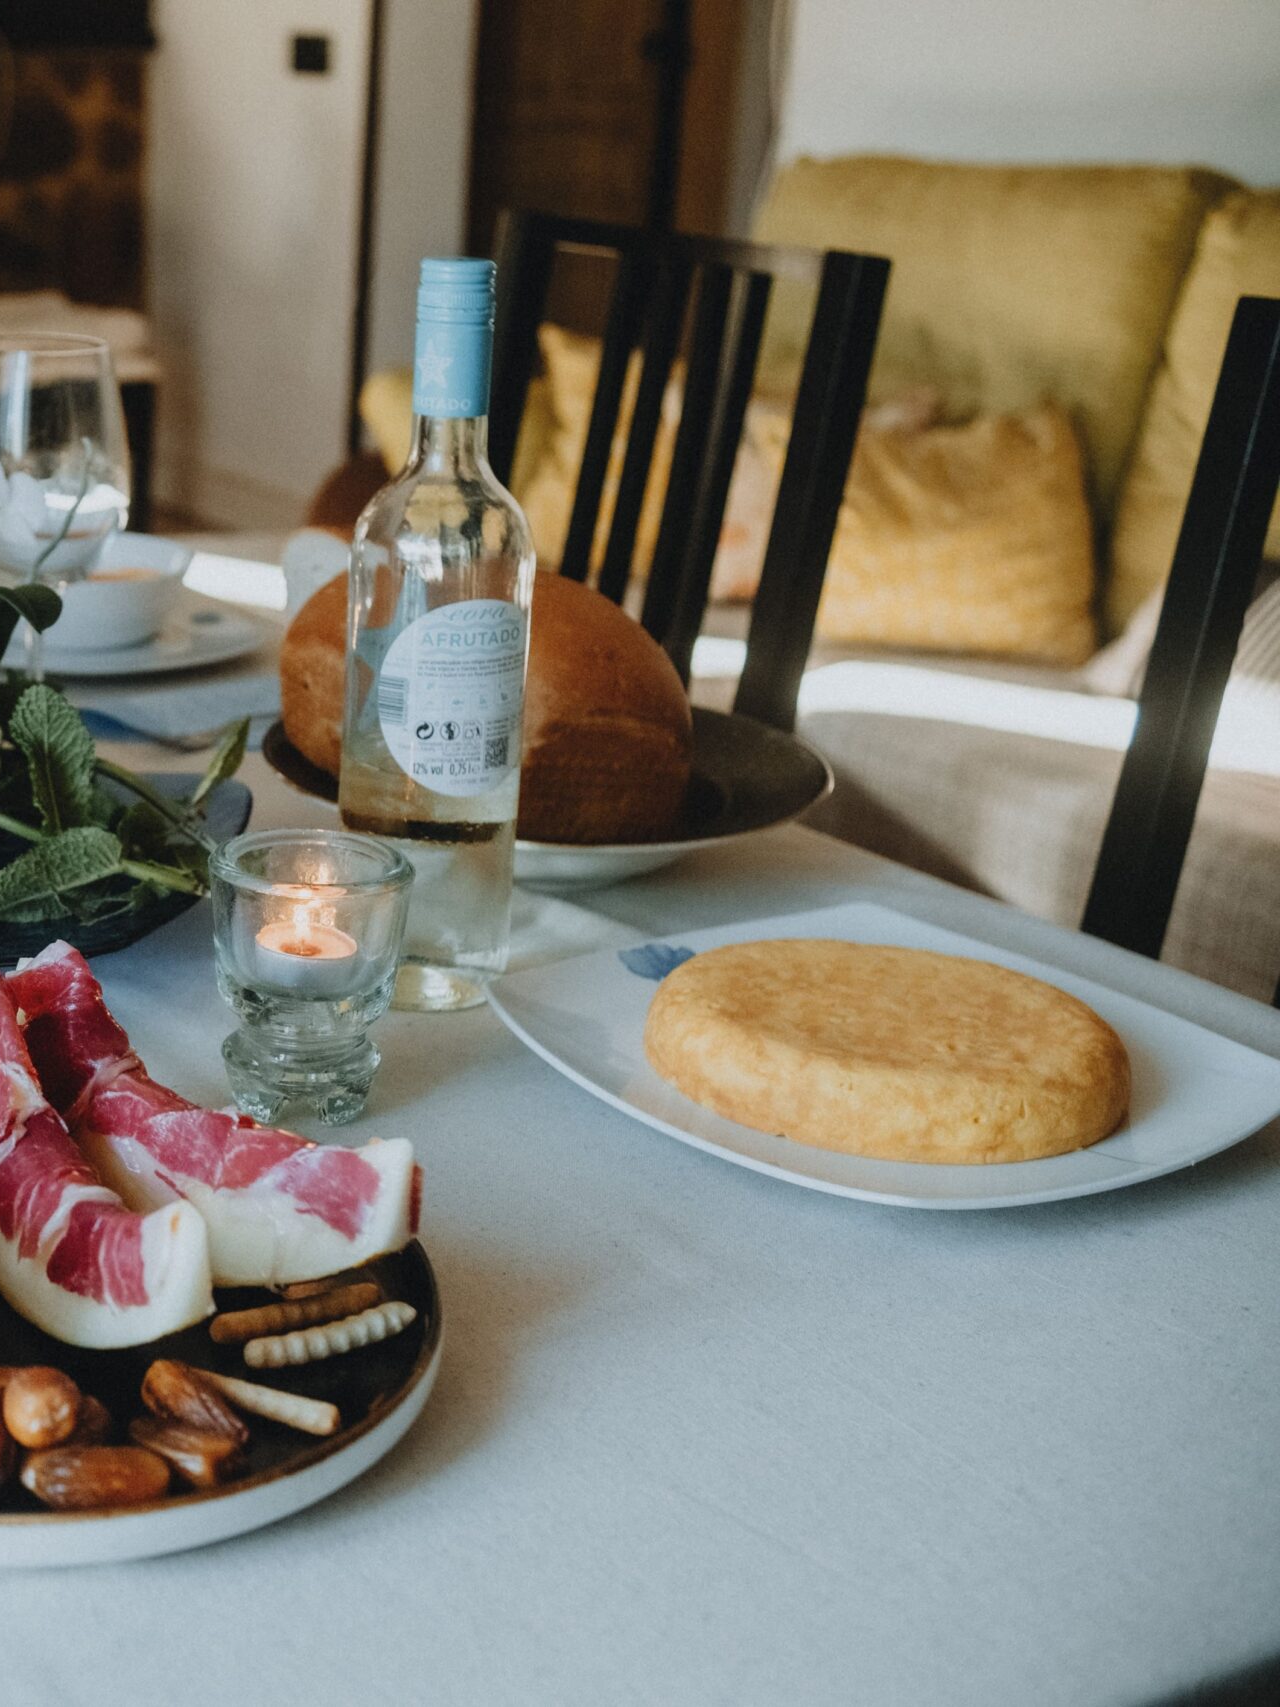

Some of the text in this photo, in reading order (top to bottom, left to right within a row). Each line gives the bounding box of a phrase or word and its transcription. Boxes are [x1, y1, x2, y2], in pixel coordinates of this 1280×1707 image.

[422, 627, 520, 648] AFRUTADO
[412, 762, 428, 775] 12%
[431, 763, 444, 776] vol
